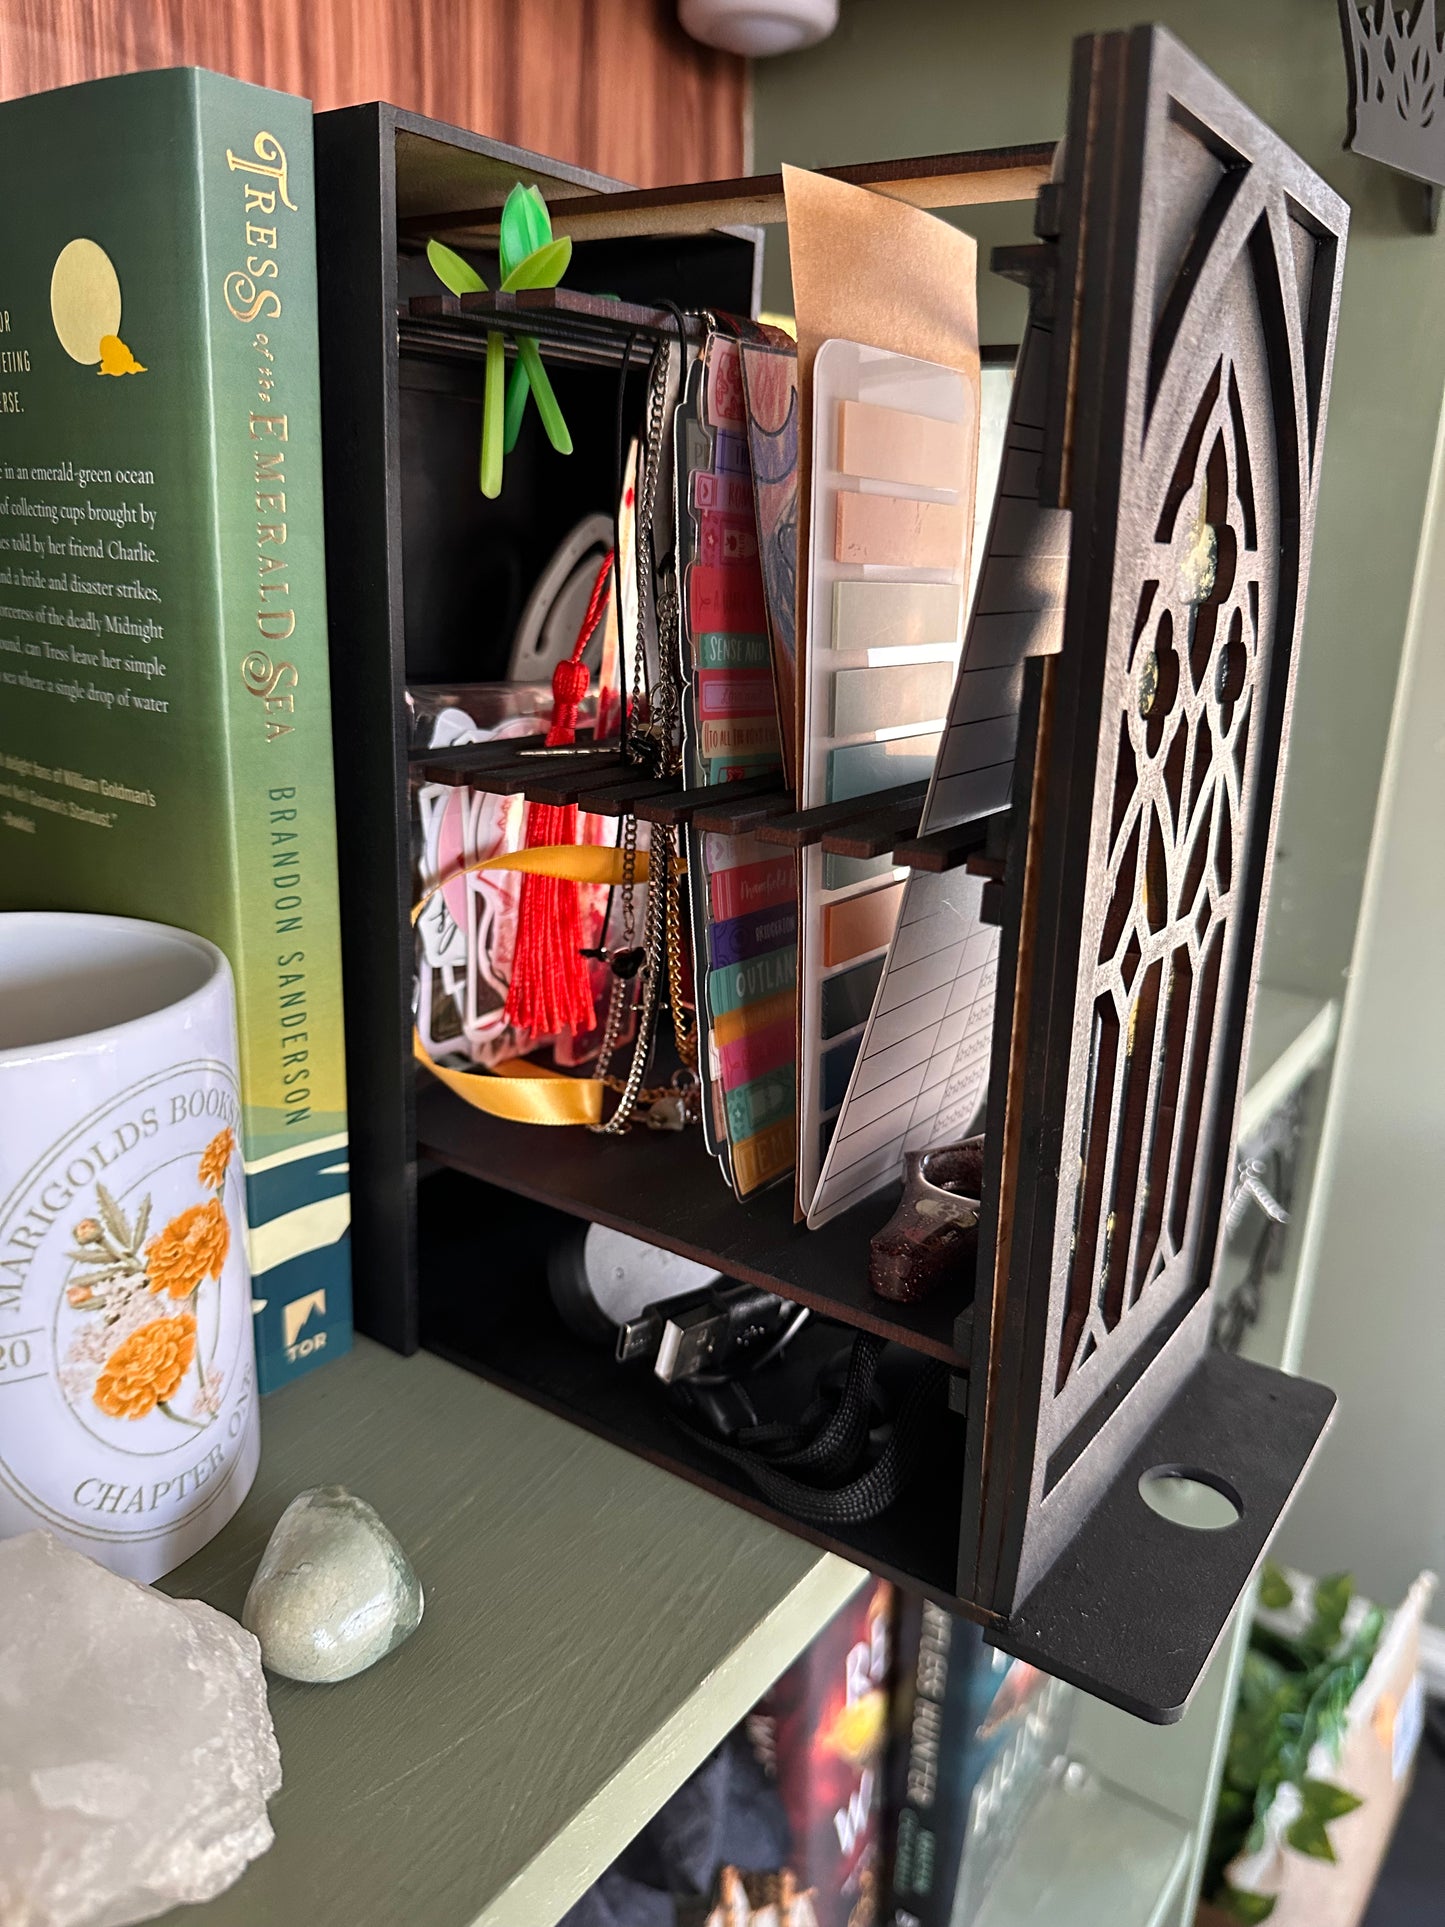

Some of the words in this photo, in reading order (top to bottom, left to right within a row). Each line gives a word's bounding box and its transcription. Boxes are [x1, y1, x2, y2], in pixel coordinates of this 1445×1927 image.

[224, 131, 298, 323] TRESS
[252, 333, 274, 362] of
[257, 367, 275, 403] the
[5, 462, 14, 480] in
[17, 467, 29, 481] an
[31, 461, 112, 488] emerald-green
[115, 469, 155, 485] ocean
[11, 497, 59, 524] collecting
[60, 505, 86, 526] cups
[87, 501, 137, 529] brought
[140, 503, 157, 530] by
[249, 410, 296, 640] EMERALD
[12, 533, 31, 553] told
[32, 534, 45, 559] by
[47, 535, 66, 556] her
[69, 536, 104, 559] friend
[107, 540, 160, 563] Charlie.
[21, 568, 47, 589] bride
[49, 573, 68, 592] and
[71, 573, 114, 597] disaster
[116, 580, 162, 603] strikes,
[36, 604, 47, 624] of
[47, 606, 65, 627] the
[66, 609, 101, 637] deadly
[104, 614, 164, 644] Midnight
[41, 640, 70, 662] Tress
[70, 644, 99, 667] leave
[101, 649, 122, 671] her
[124, 655, 167, 680] simple
[710, 635, 742, 662] SENSE
[55, 678, 86, 703] single
[86, 681, 115, 709] drop
[117, 687, 132, 707] of
[132, 697, 169, 714] water
[240, 650, 298, 743] SEA
[709, 729, 718, 748] TO
[268, 786, 303, 934] BRANDON
[277, 951, 311, 1126] SANDERSON
[0, 1106, 160, 1314] MARIGOLDS
[286, 1331, 328, 1364] TOR
[73, 1442, 226, 1514] CHAPTER
